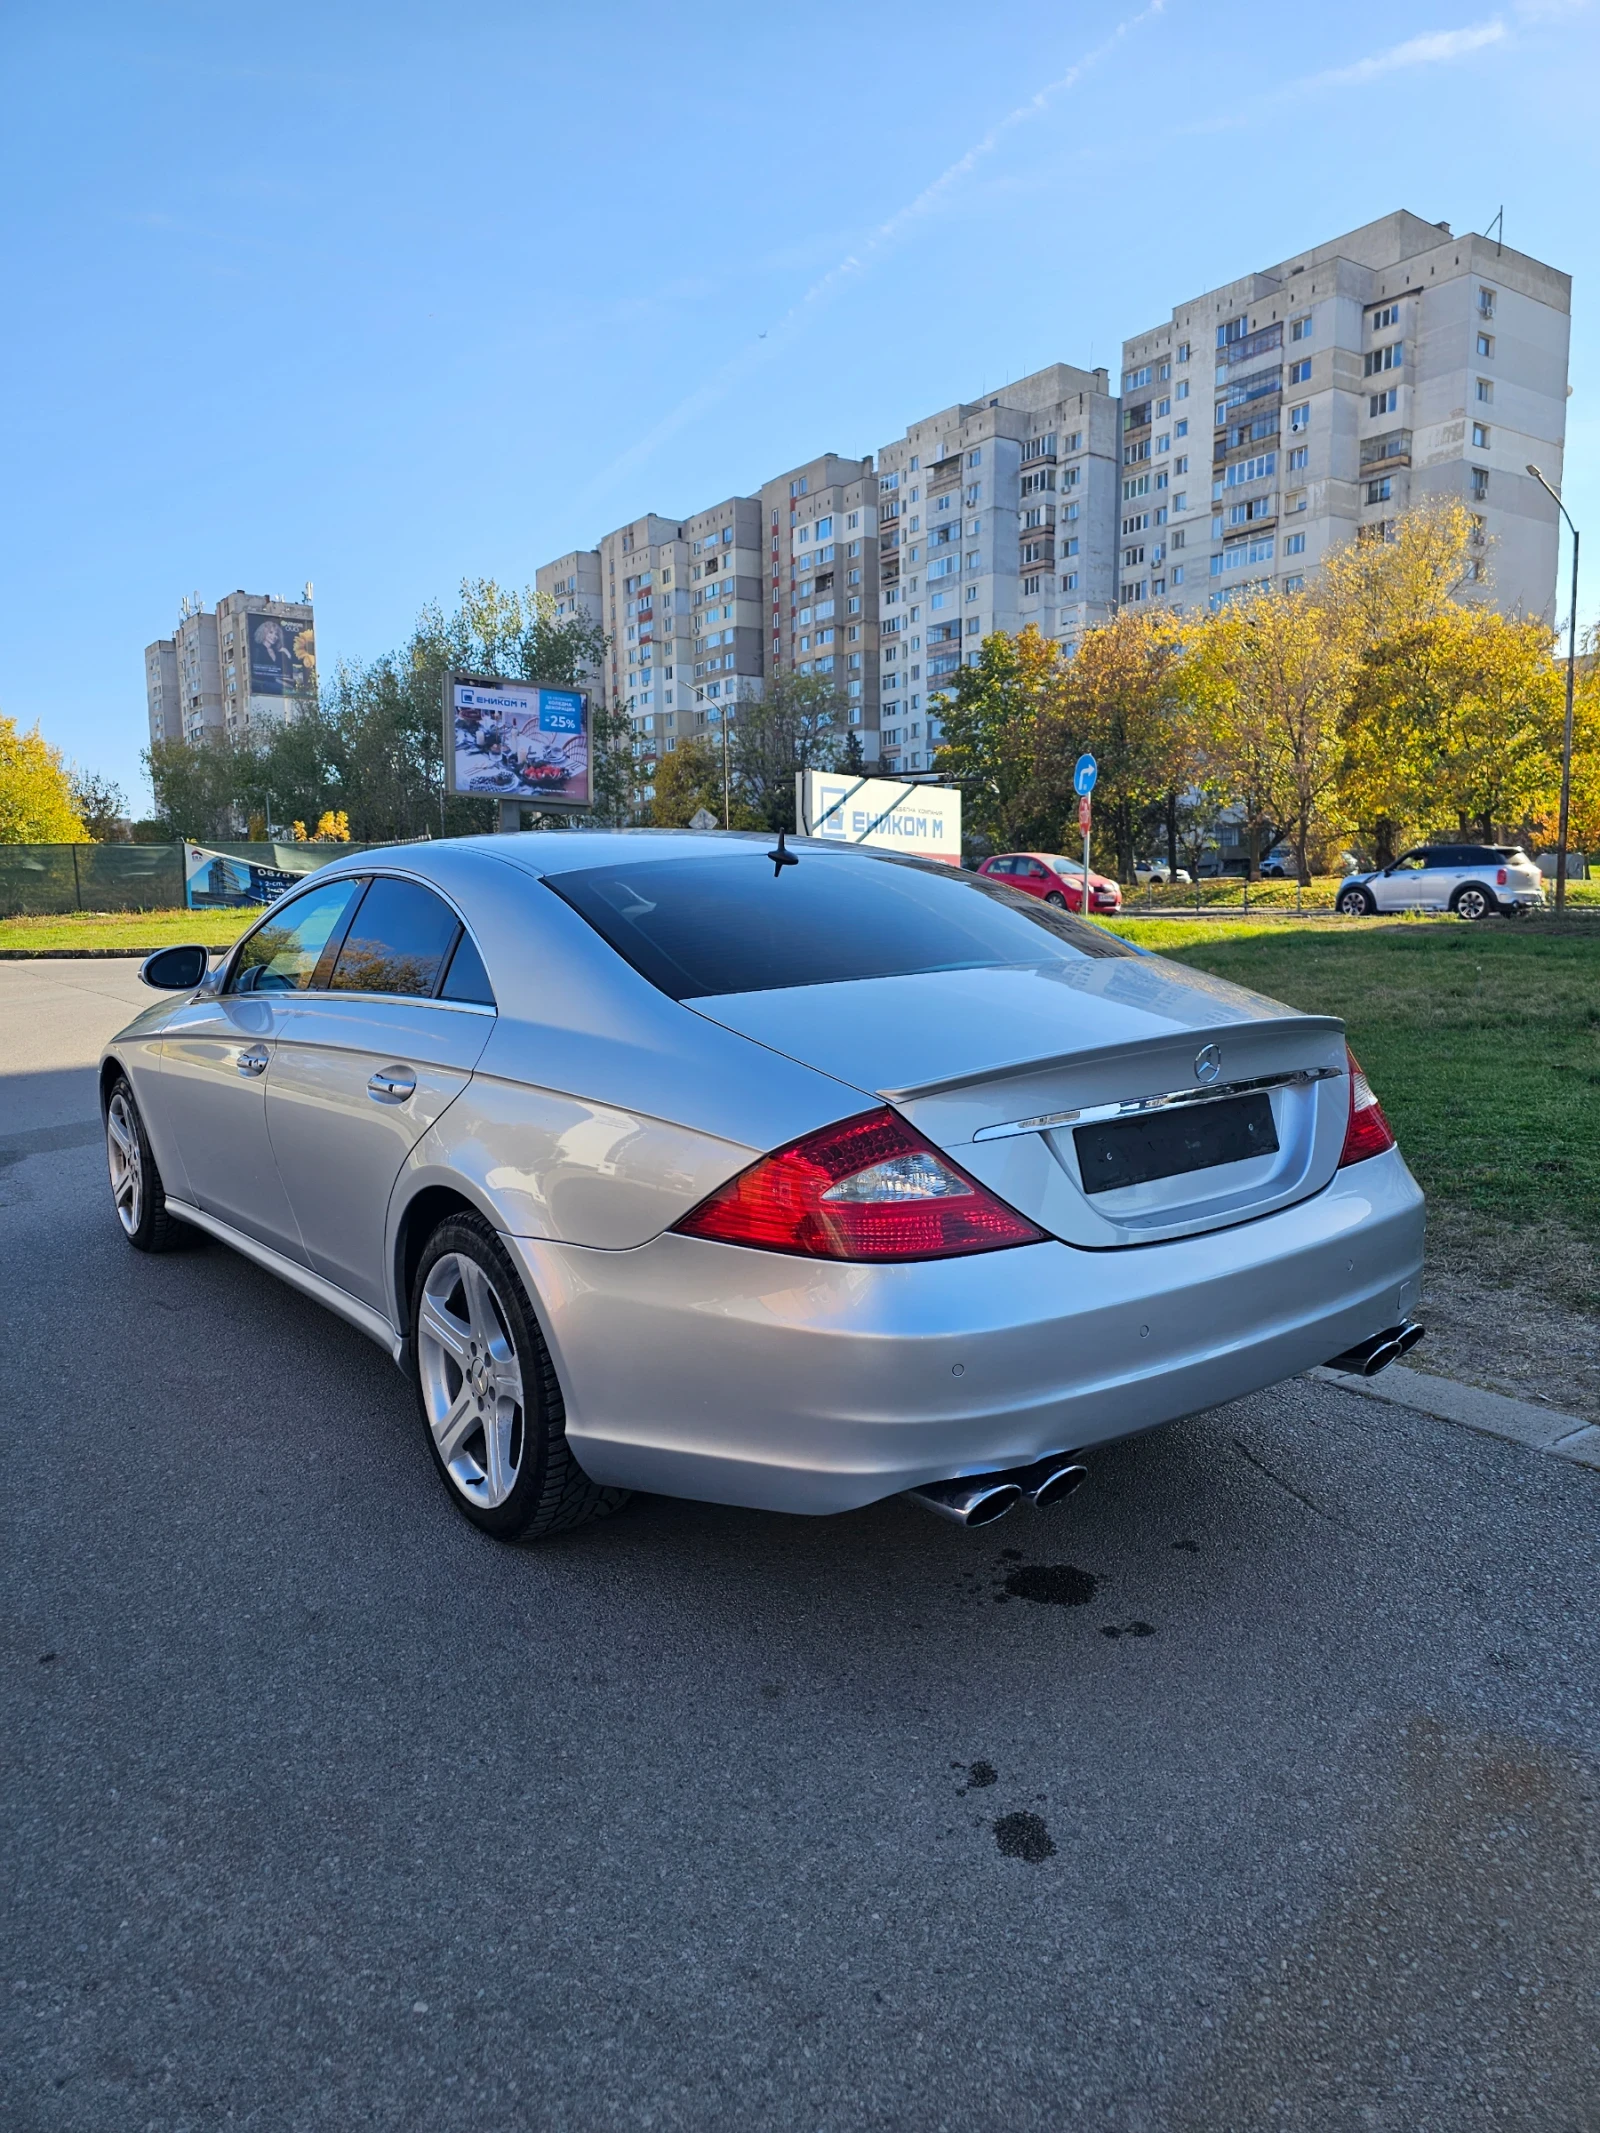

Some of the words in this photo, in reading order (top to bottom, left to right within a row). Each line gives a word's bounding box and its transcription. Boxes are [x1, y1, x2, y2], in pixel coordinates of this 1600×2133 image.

[476, 696, 518, 708] ЕНИКОМ
[852, 811, 927, 837] ЕНИКОМ
[932, 818, 943, 839] М
